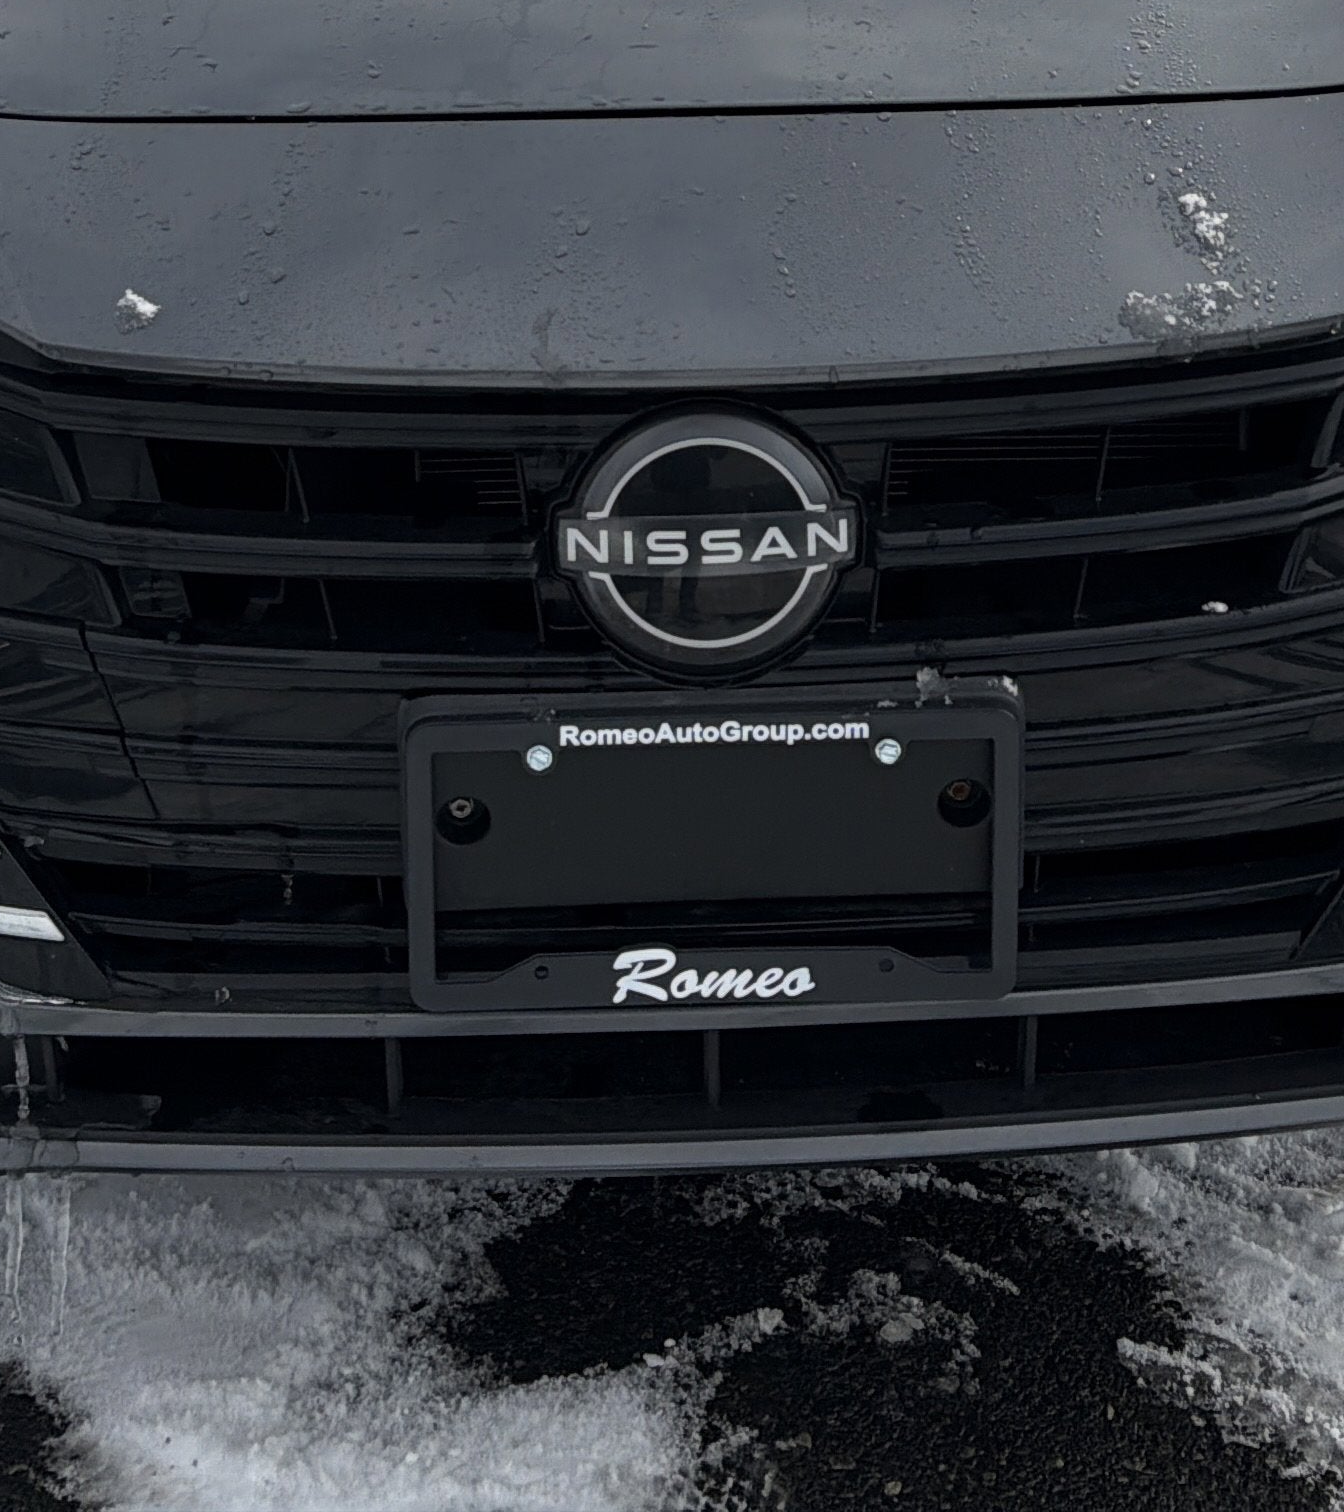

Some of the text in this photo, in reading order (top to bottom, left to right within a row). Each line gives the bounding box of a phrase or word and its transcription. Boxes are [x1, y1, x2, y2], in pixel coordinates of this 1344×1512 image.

[566, 518, 848, 565] NISSAN
[559, 720, 870, 747] RomeoAutoGroup.com
[612, 948, 816, 1004] Romeo
